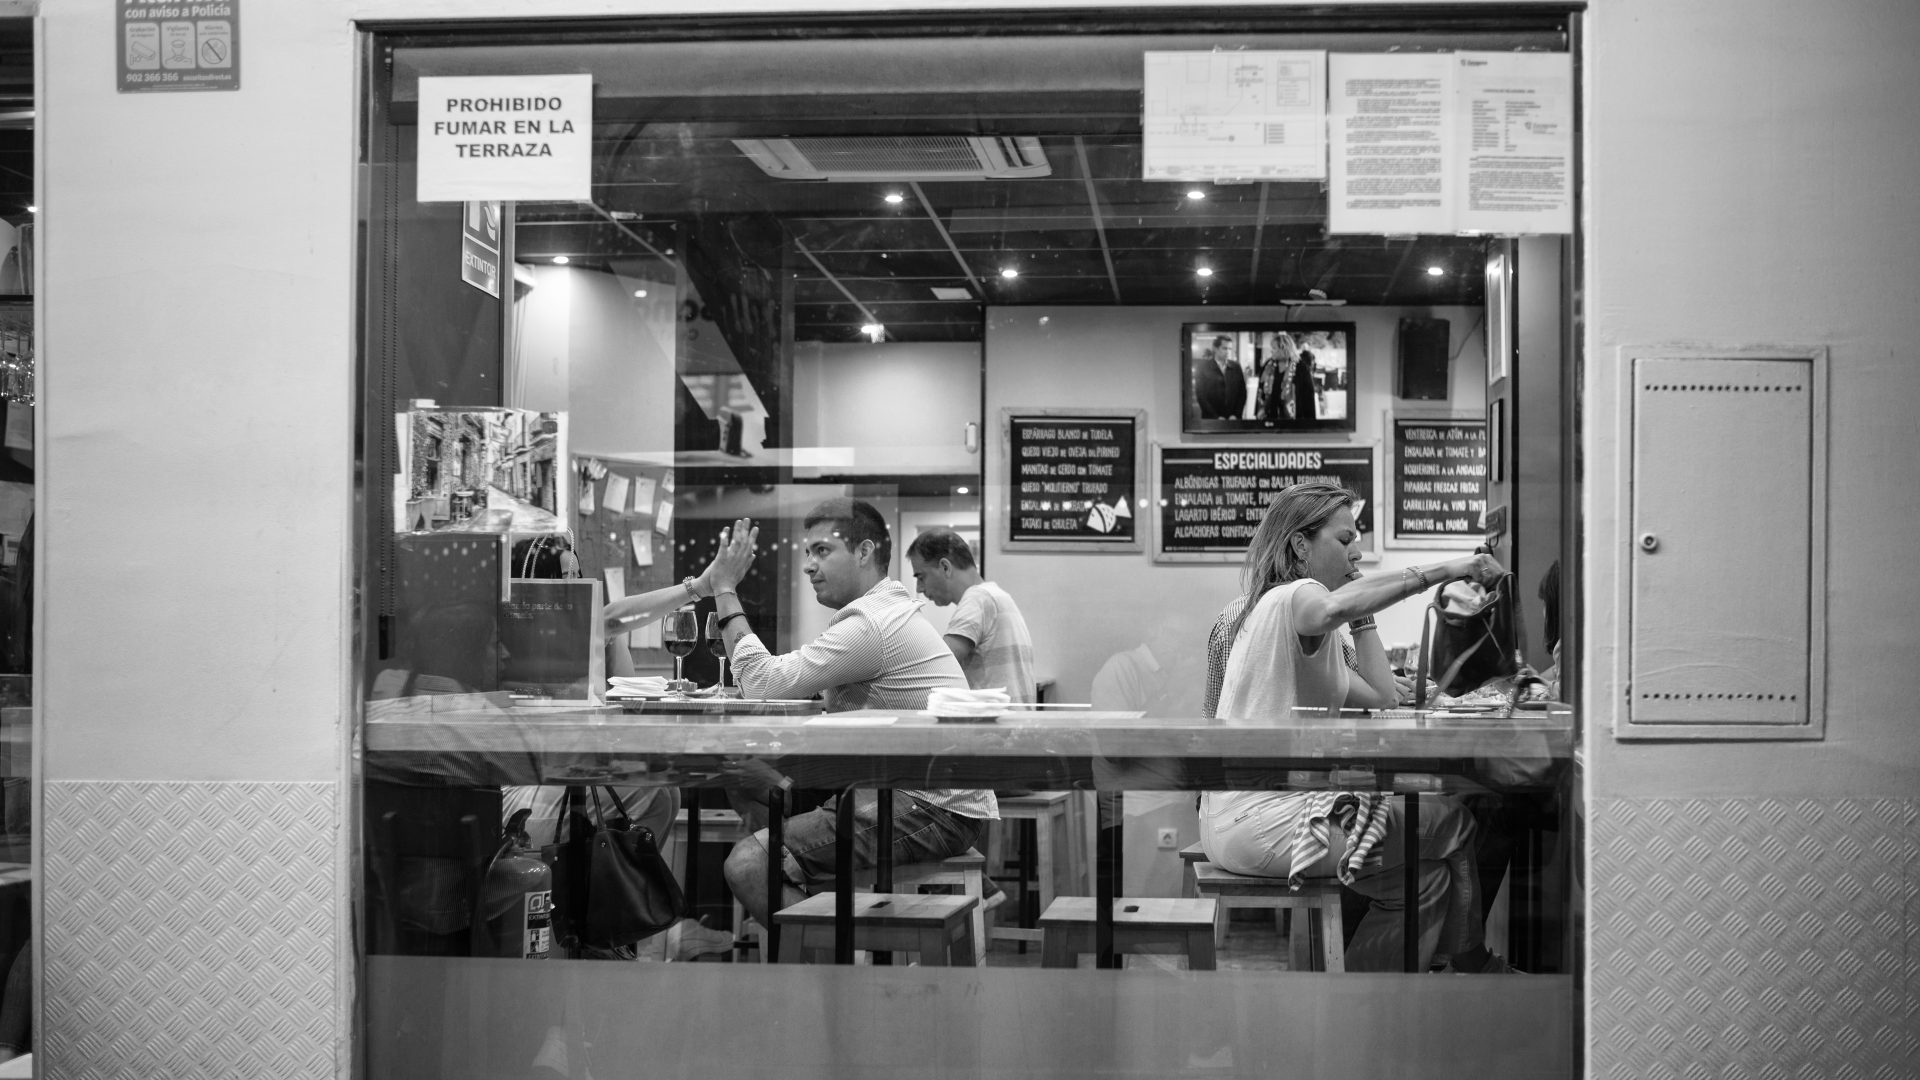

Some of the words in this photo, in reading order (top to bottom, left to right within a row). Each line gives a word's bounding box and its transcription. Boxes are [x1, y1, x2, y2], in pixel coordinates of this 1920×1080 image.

[126, 8, 146, 18] con
[149, 5, 180, 18] aviso
[182, 8, 189, 17] a
[192, 4, 231, 17] Policía
[127, 74, 143, 82] 902
[144, 73, 160, 82] 366
[162, 73, 178, 81] 366
[446, 97, 562, 112] PROHIBIDO
[434, 120, 507, 135] FUMAR
[514, 120, 541, 134] EN
[549, 119, 575, 134] LA
[455, 143, 552, 158] TERRAZA
[464, 251, 496, 278] EXTINTOR
[1022, 427, 1056, 440] ESPÁRRAGO
[1057, 429, 1081, 440] BLANCO
[1090, 429, 1113, 440] TUDELA
[1404, 428, 1438, 441] VENTRESCA
[1446, 427, 1463, 441] ATÚN
[1470, 432, 1477, 440] LA
[1021, 446, 1040, 457] QUESO
[1042, 446, 1059, 457] VIEJO
[1068, 446, 1087, 457] OVEJA
[1096, 446, 1120, 458] PIRINEO
[1404, 446, 1436, 458] ENSALADA
[1445, 446, 1468, 458] TOMATE
[1214, 452, 1322, 470] ESPECIALIDADES
[1021, 464, 1049, 475] MANITAS
[1058, 464, 1076, 475] CERDO
[1088, 464, 1113, 476] TOMATE
[1404, 463, 1440, 475] BOQUERONES
[1021, 482, 1040, 493] QUESO
[1082, 482, 1108, 494] TRUFADO
[1174, 474, 1219, 489] ALBÓNDIGAS
[1221, 476, 1257, 488] TRUFADAS
[1271, 475, 1294, 488] SALSA
[1404, 481, 1432, 493] PIPARRAS
[1433, 481, 1459, 493] FRESCAS
[1459, 481, 1479, 493] FRITAS
[1225, 492, 1256, 507] TOMATE,
[1403, 499, 1441, 511] CARRILLERAS
[1451, 499, 1466, 511] VINO
[1174, 508, 1208, 521] LAGARTO
[1210, 506, 1237, 521] IBÉRICO
[1021, 518, 1042, 529] TATAKI
[1051, 518, 1078, 530] CHULETA
[1402, 518, 1434, 531] PIMIENTOS
[1445, 517, 1468, 531] PADRÓN
[1174, 525, 1219, 538] ALCACHOFAS
